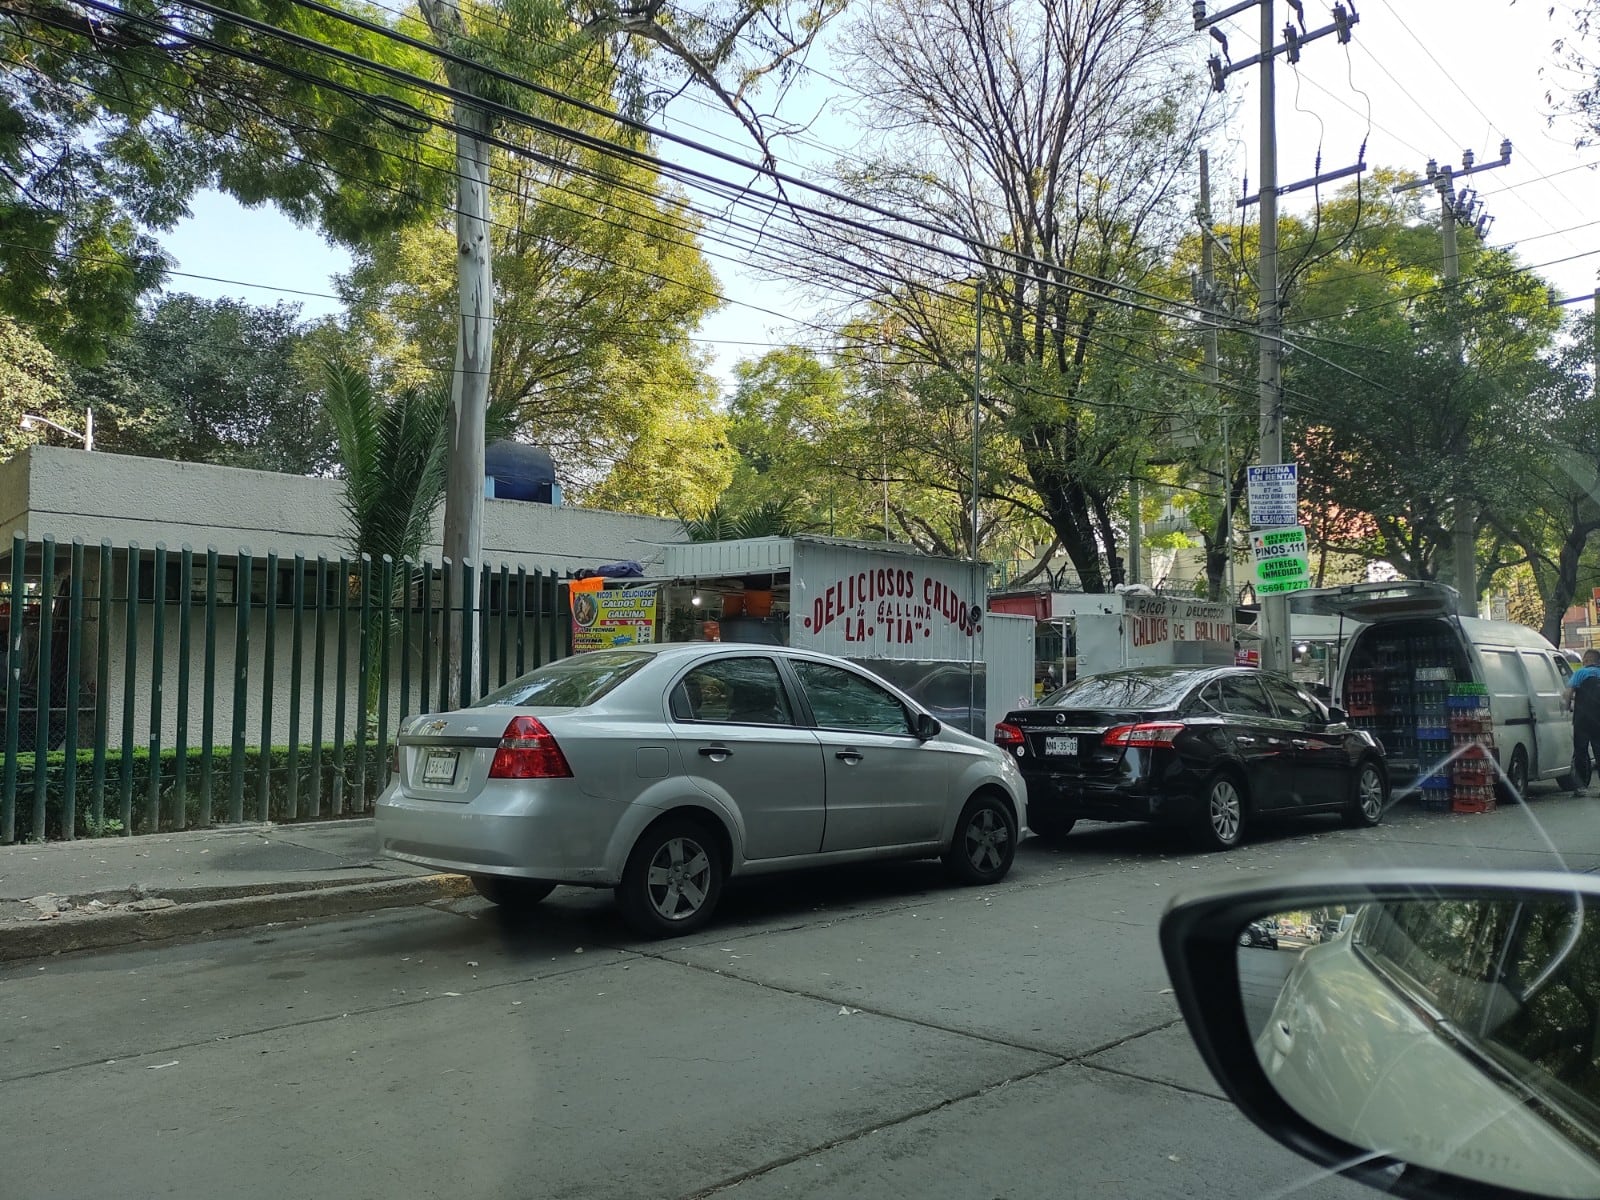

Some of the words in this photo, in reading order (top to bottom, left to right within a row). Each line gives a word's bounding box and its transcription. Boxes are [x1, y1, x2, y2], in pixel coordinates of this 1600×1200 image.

[1254, 466, 1290, 474] OFICINA
[1265, 473, 1294, 481] RENTA
[1255, 545, 1285, 557] PINOS
[1264, 559, 1298, 570] ENTREGA
[1262, 567, 1303, 579] INMEDIATA
[1262, 583, 1285, 593] 5696
[1287, 581, 1308, 590] 7273
[602, 599, 635, 608] CALDOS
[640, 598, 654, 607] DE
[814, 568, 914, 635] DELICIOSOS
[877, 600, 932, 620] GALLINA
[1138, 600, 1165, 615] RICOS
[1172, 605, 1178, 616] Y
[607, 610, 646, 619] GALLINA
[845, 617, 865, 642] LA
[1133, 617, 1168, 647] CALDOS
[1173, 624, 1185, 640] DE
